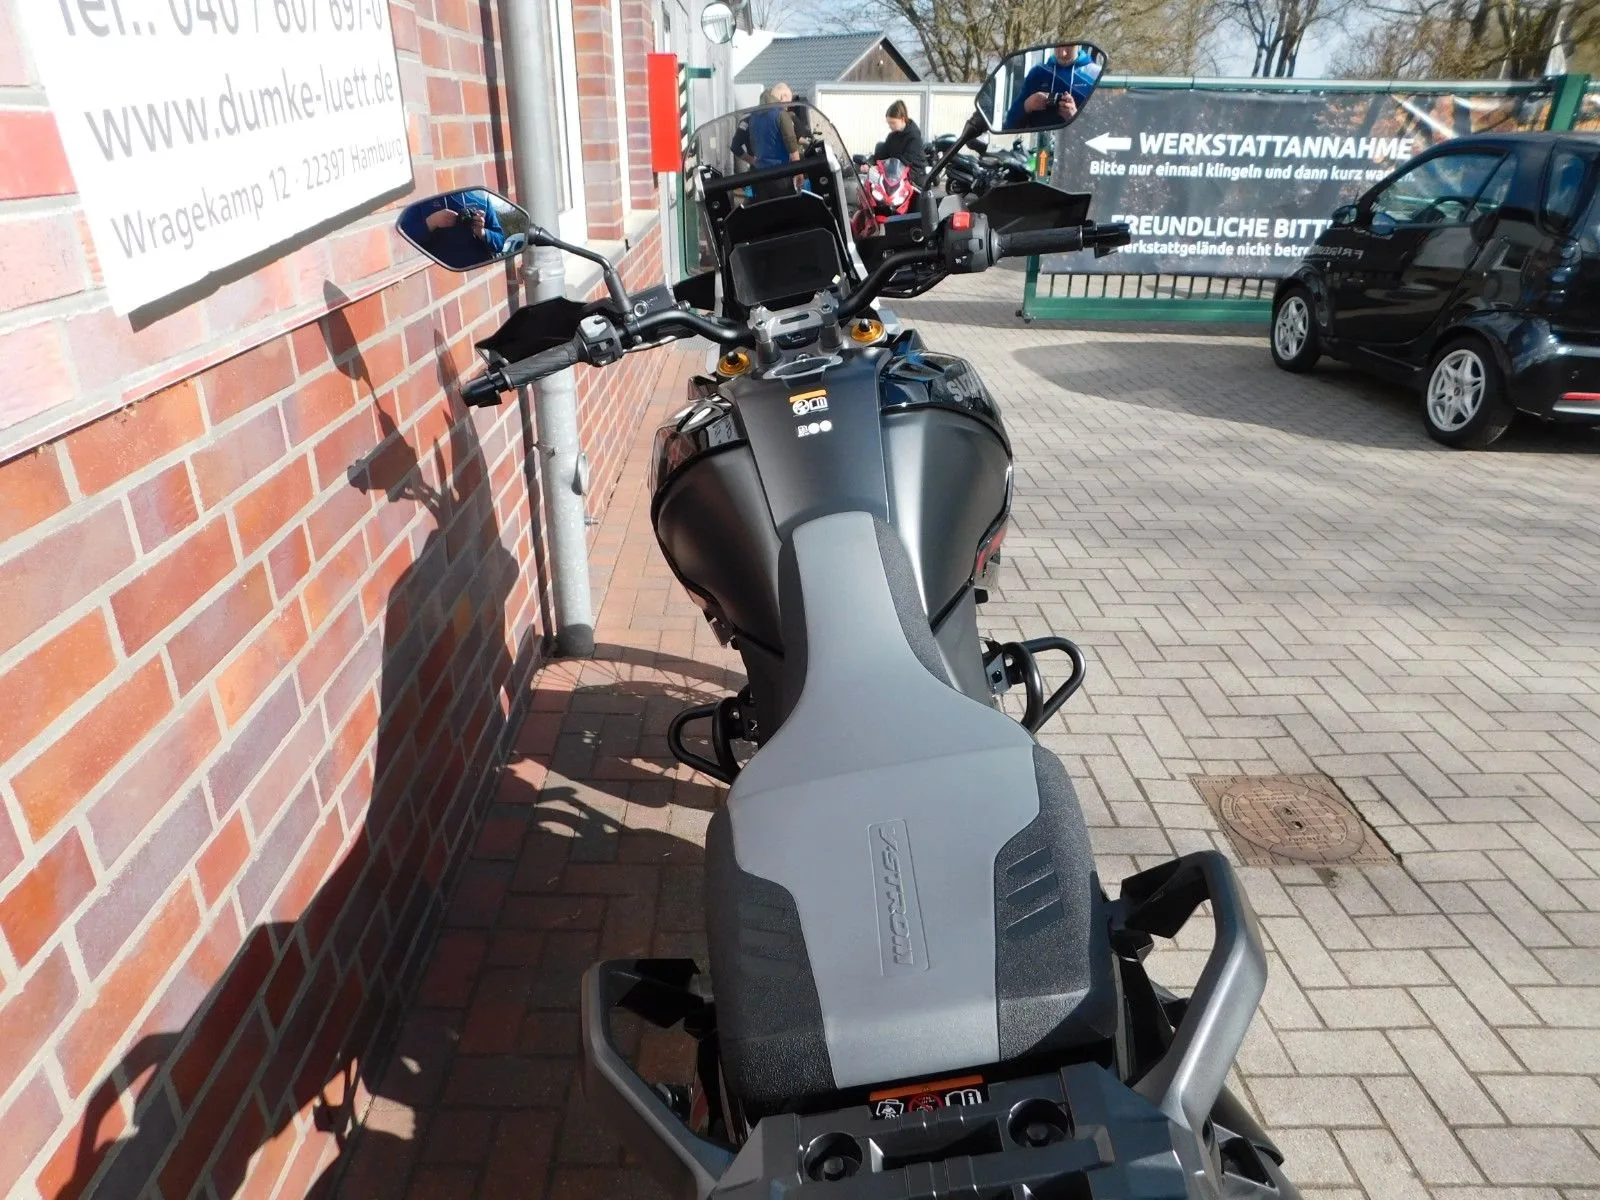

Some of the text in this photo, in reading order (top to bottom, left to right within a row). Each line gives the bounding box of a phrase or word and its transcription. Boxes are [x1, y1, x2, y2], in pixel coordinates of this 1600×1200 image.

[84, 63, 395, 163] www.dumke-luett.de
[1139, 131, 1415, 161] WERKSTATTANNAHME
[1089, 160, 1127, 177] Bitte
[1128, 164, 1154, 177] nur
[1155, 160, 1203, 179] einmal
[1205, 161, 1262, 182] klingeln
[1264, 165, 1291, 180] und
[1294, 165, 1329, 180] dann
[1330, 165, 1363, 181] kurz
[109, 136, 404, 260] Wragekamp 12 22397 Hamburg
[1236, 242, 1272, 257] nicht
[1274, 242, 1310, 257] betr
